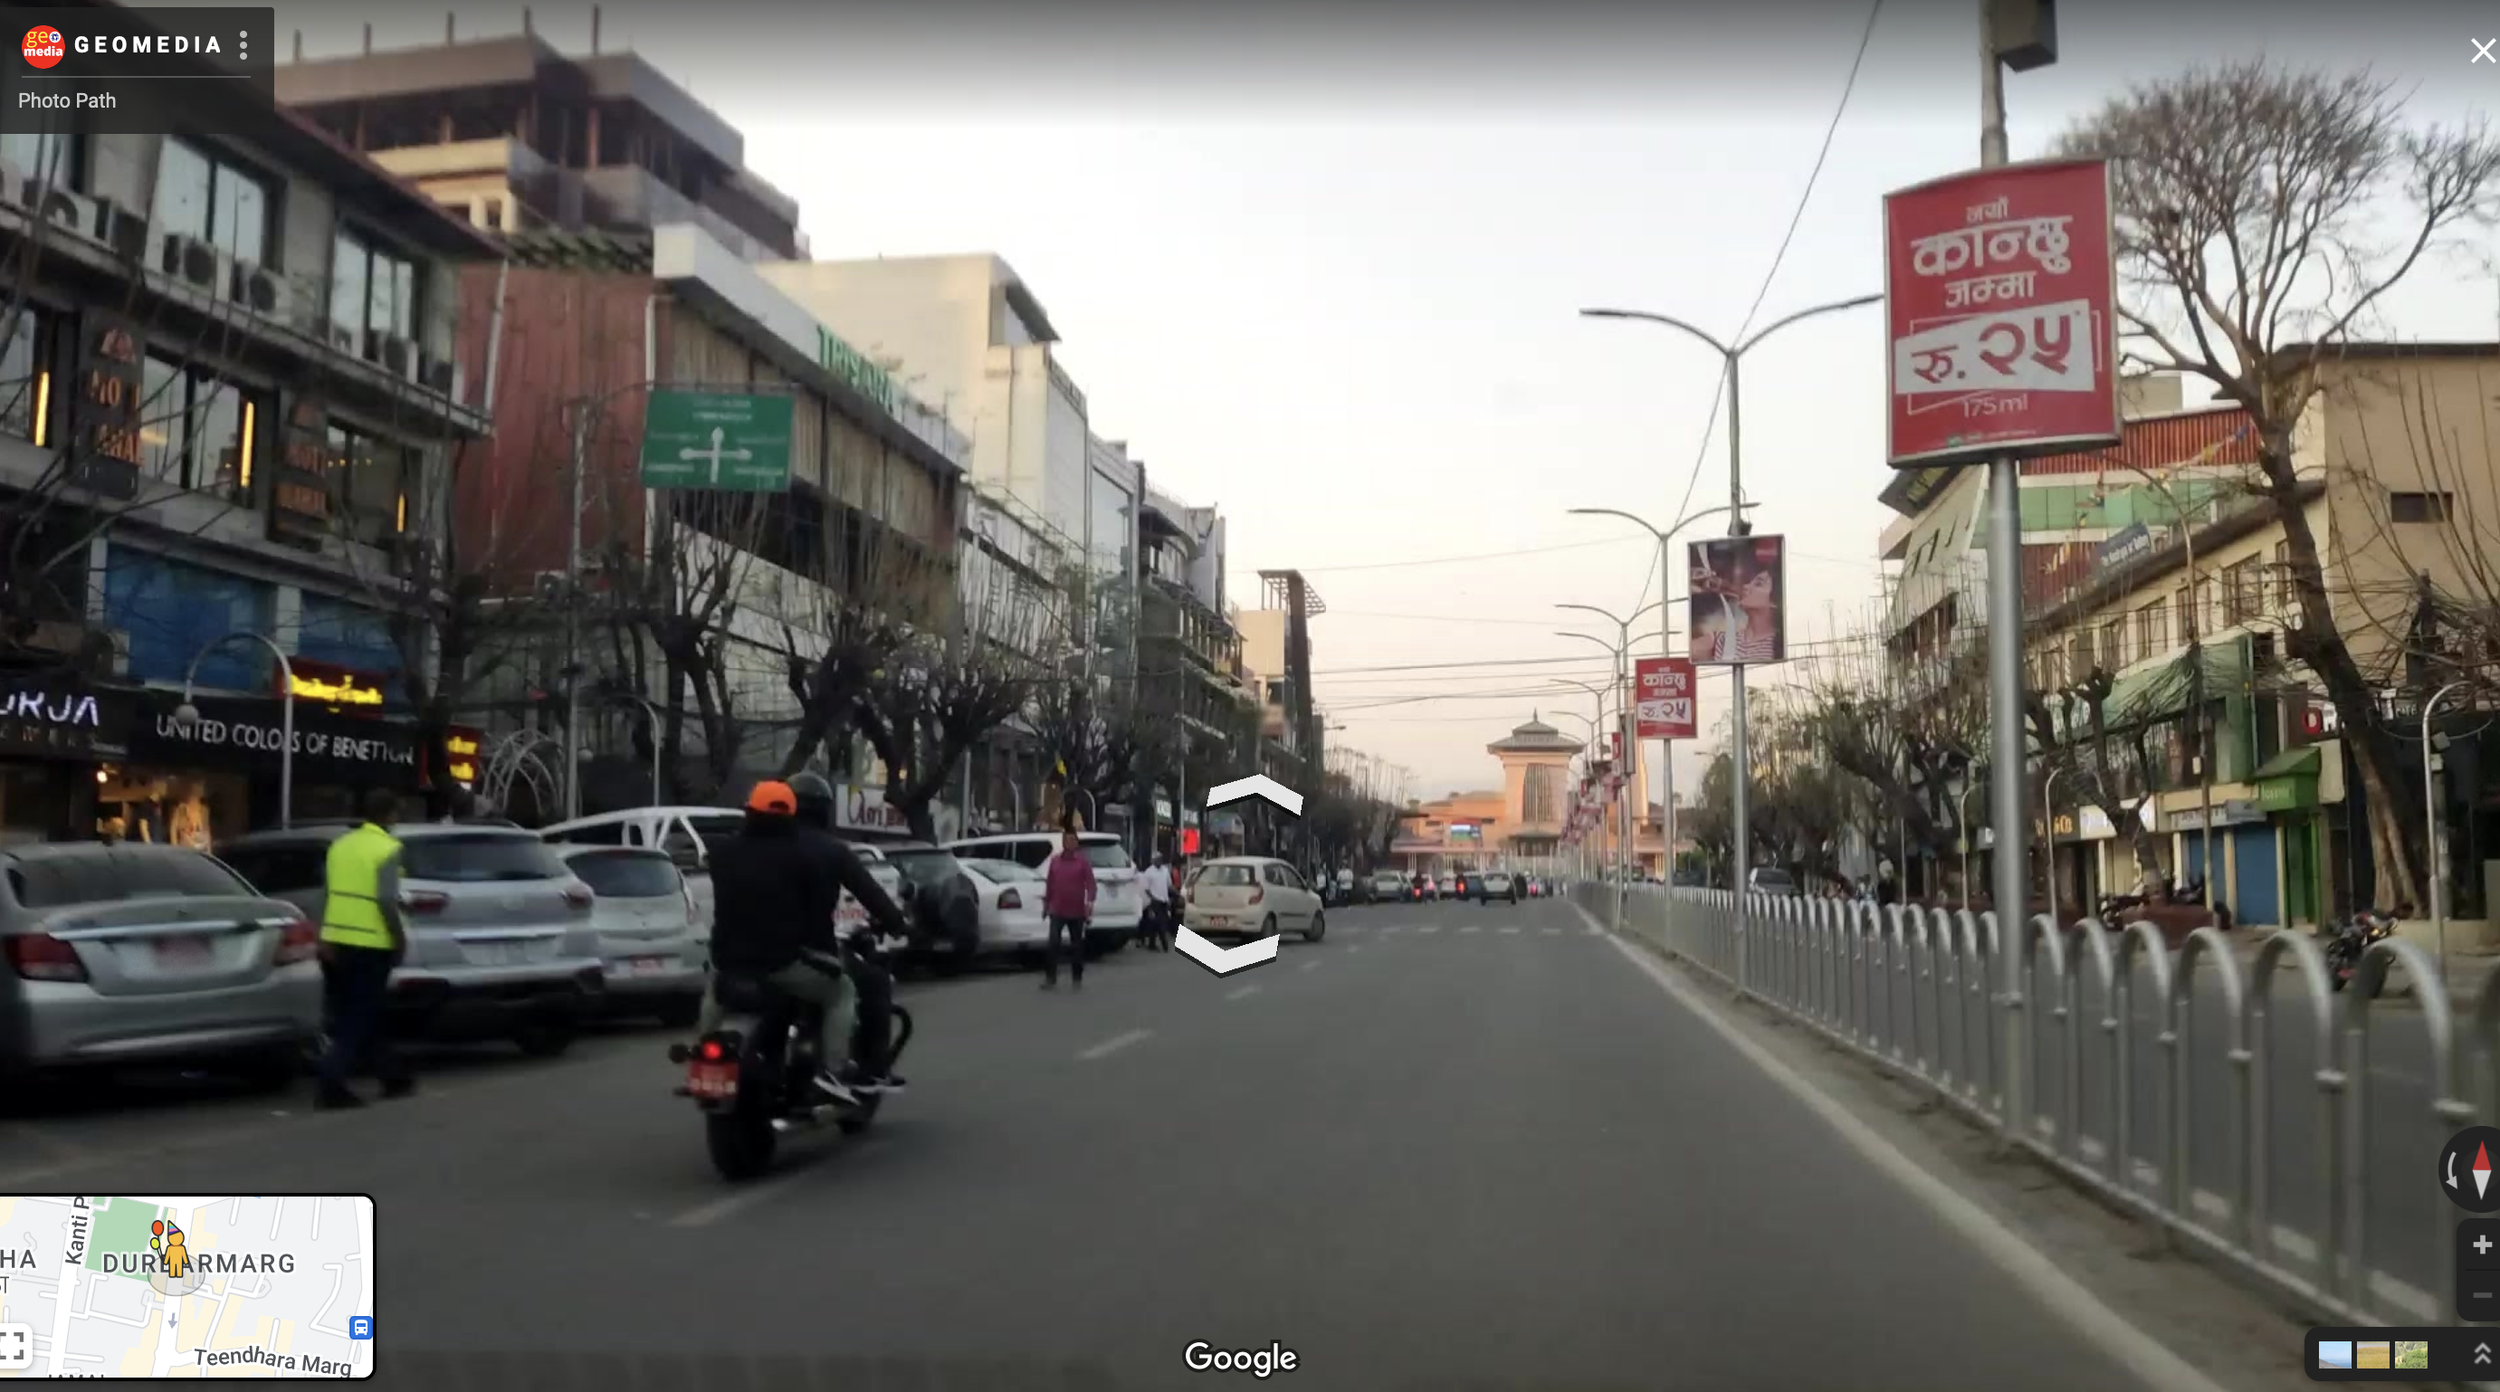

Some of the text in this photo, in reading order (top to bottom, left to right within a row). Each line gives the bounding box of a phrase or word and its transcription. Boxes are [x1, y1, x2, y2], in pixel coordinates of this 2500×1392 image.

[1945, 271, 2037, 308] जम्मा
[156, 713, 227, 744] UNITED
[232, 723, 301, 753] COLOS
[305, 732, 329, 755] OF
